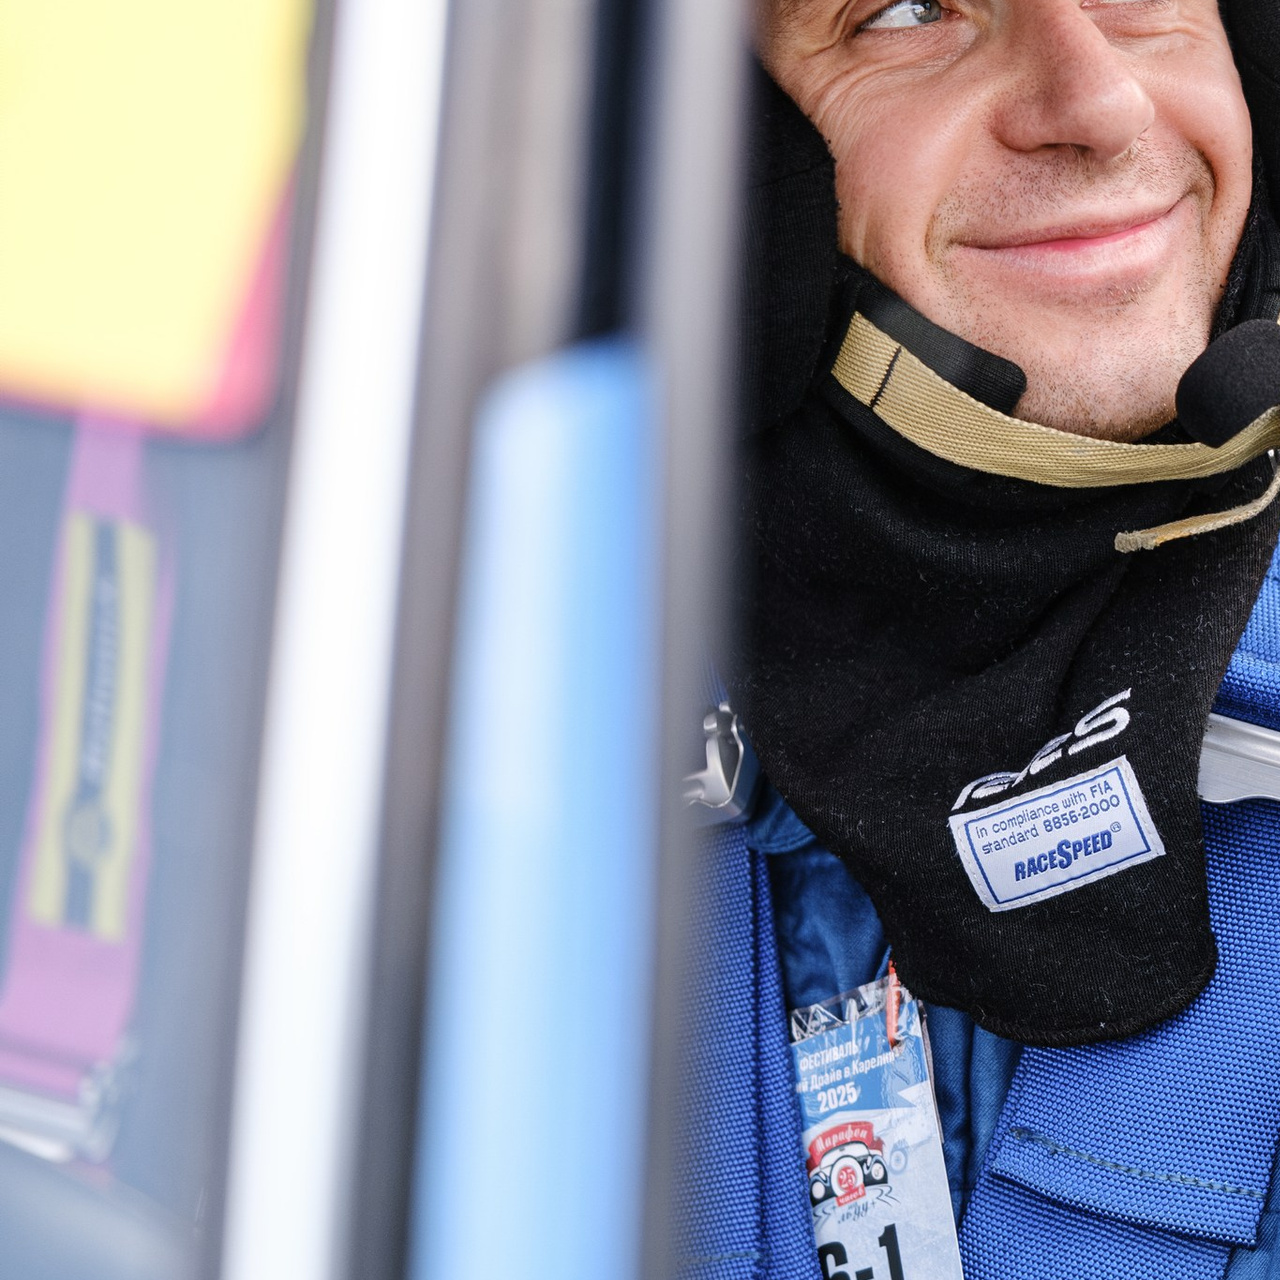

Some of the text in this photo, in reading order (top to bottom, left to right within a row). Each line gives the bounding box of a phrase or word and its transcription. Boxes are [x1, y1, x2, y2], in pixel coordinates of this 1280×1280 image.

[992, 801, 1060, 835] compliance
[1062, 790, 1087, 810] with
[1090, 780, 1113, 797] FIA
[981, 794, 1120, 855] standard 8856-2000
[800, 1041, 859, 1070] ФЕСТИВАЛЬ
[810, 1069, 842, 1091] Драйв
[843, 1067, 850, 1078] в
[817, 1082, 858, 1113] 2025
[839, 1168, 856, 1188] 25
